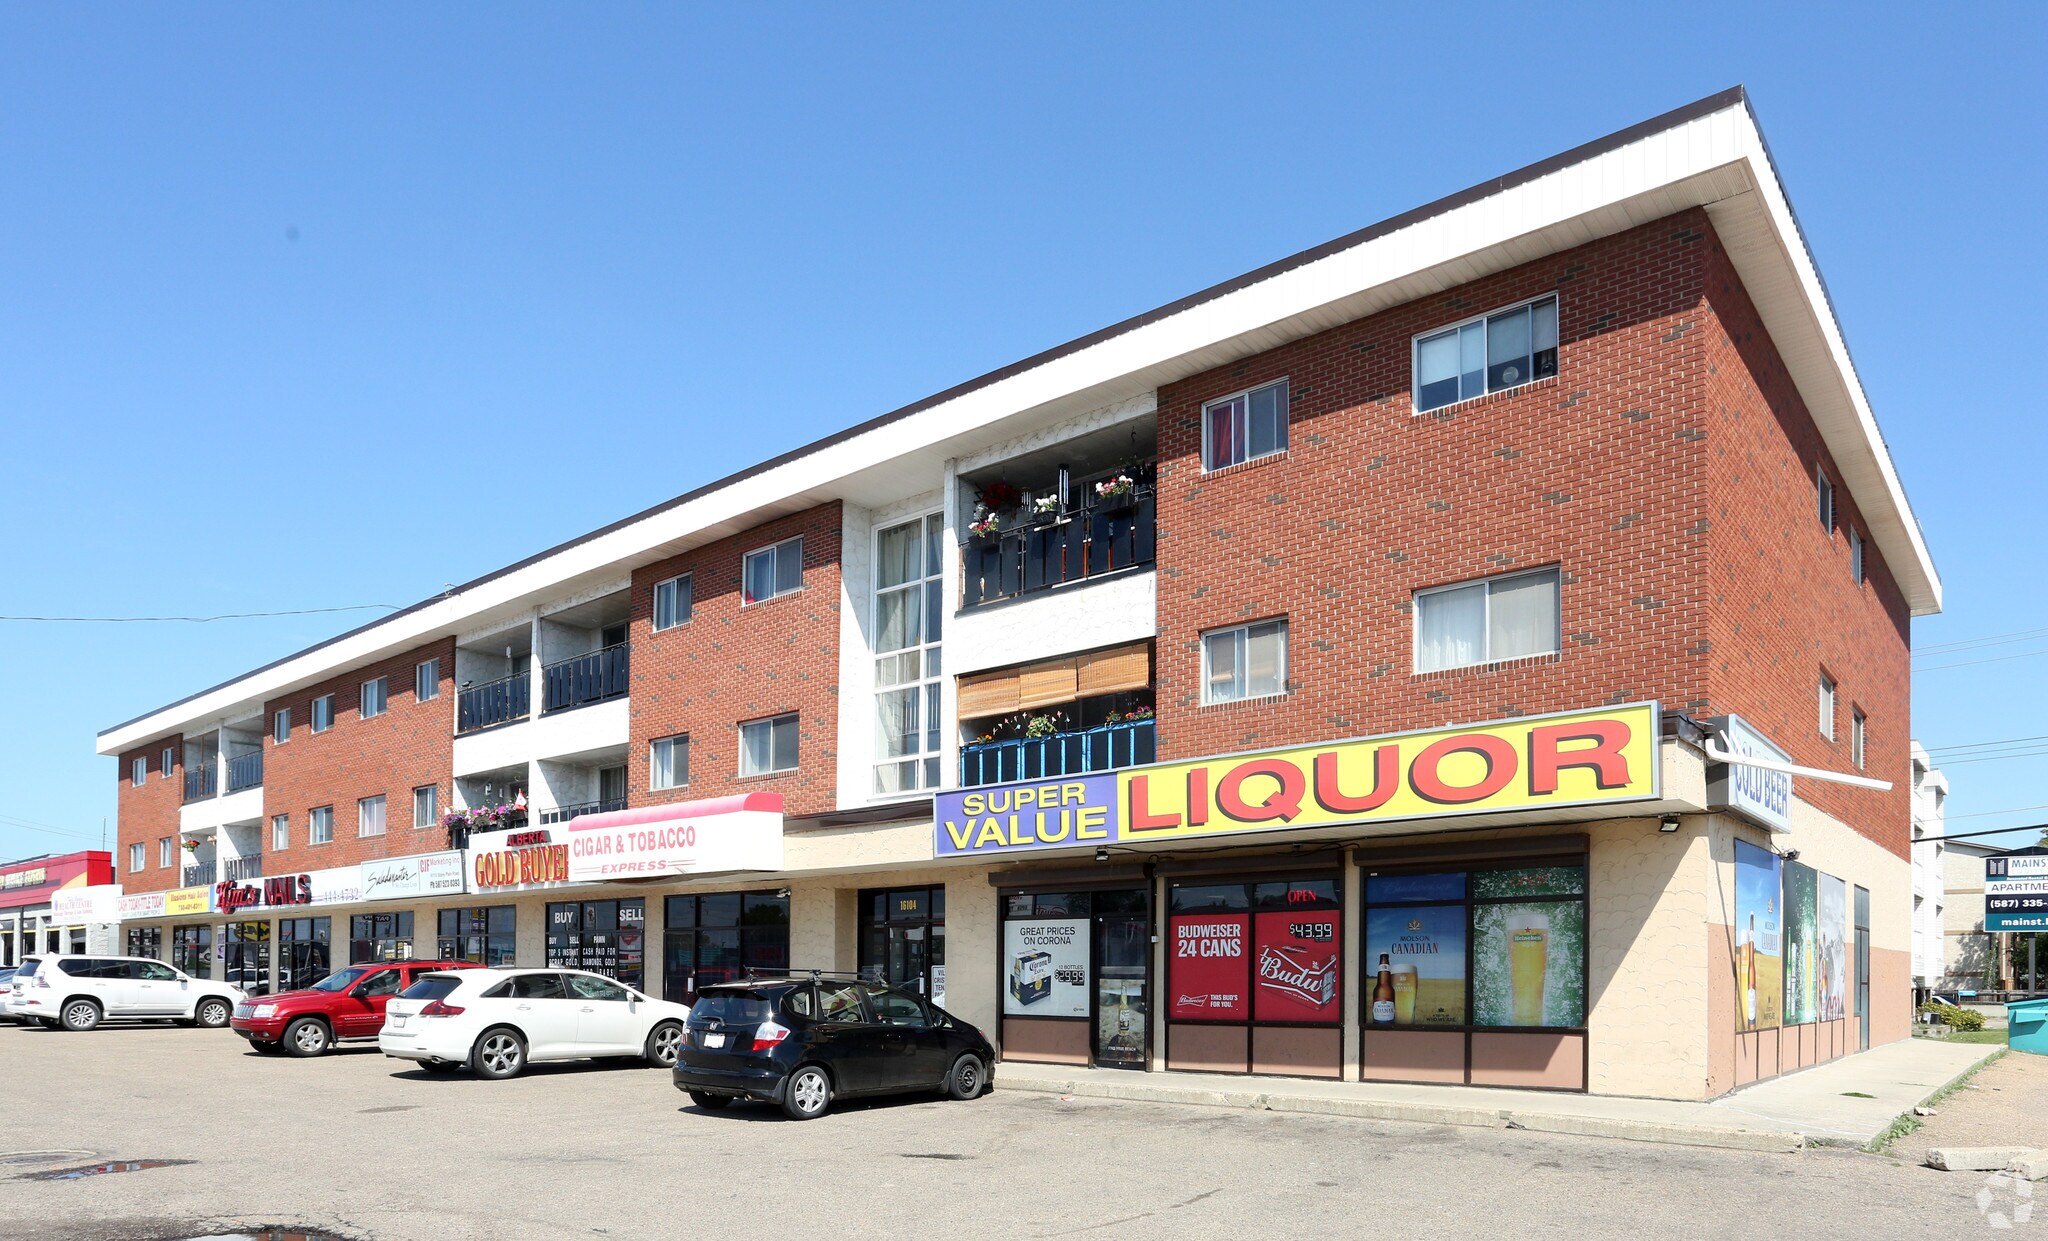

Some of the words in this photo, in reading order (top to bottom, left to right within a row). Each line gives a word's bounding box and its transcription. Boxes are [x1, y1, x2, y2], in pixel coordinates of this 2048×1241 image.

[1128, 719, 1633, 832] LIQUOR
[1735, 735, 1762, 803] COLD
[1764, 757, 1788, 819] BEER
[962, 782, 1087, 816] SUPER
[944, 805, 1108, 850] VALUE
[507, 831, 547, 847] ALBERTA
[573, 836, 612, 858] CIGAR
[615, 834, 625, 854] &
[628, 825, 696, 852] TOBACCO
[430, 857, 452, 866] Marketing
[601, 859, 667, 874] EXPRESS
[2011, 858, 2048, 869] MAINS
[475, 850, 515, 888] GOLD
[187, 892, 197, 900] Hair
[197, 890, 209, 899] Salon
[216, 880, 260, 915] Kim's
[264, 874, 312, 906] NAILS
[1287, 889, 1317, 903] OPEN
[59, 901, 75, 911] HEALTH
[76, 899, 93, 909] CENTRE
[118, 898, 127, 912] CASH
[151, 894, 164, 908] TODAY
[900, 899, 917, 911] 16104
[1990, 899, 2019, 909] (587)
[2022, 899, 2048, 908] 335-
[554, 911, 573, 924] BUY
[619, 908, 643, 921] SELL
[2001, 917, 2048, 926] mainst.
[1020, 927, 1045, 936] GREAT
[1047, 926, 1076, 936] PRICES
[1178, 924, 1241, 938] BUDWEISER
[1289, 923, 1333, 938] $43.99
[549, 937, 557, 945] BUY
[569, 936, 579, 944] SELL
[593, 935, 606, 944] PAWN
[1024, 937, 1036, 945] ON
[1037, 936, 1072, 945] CORONA
[548, 948, 556, 957] TOP
[562, 948, 579, 956] INSTANT
[582, 947, 594, 956] CASH
[595, 947, 605, 956] PAID
[607, 947, 616, 956] FOR
[1178, 940, 1197, 957] 24
[1200, 939, 1241, 957] CANS
[1391, 942, 1439, 954] CANADIAN
[605, 958, 616, 966] GOLD
[1029, 958, 1048, 972] Corona
[1054, 969, 1085, 982] $29.99
[1179, 996, 1207, 1004] Budweiser
